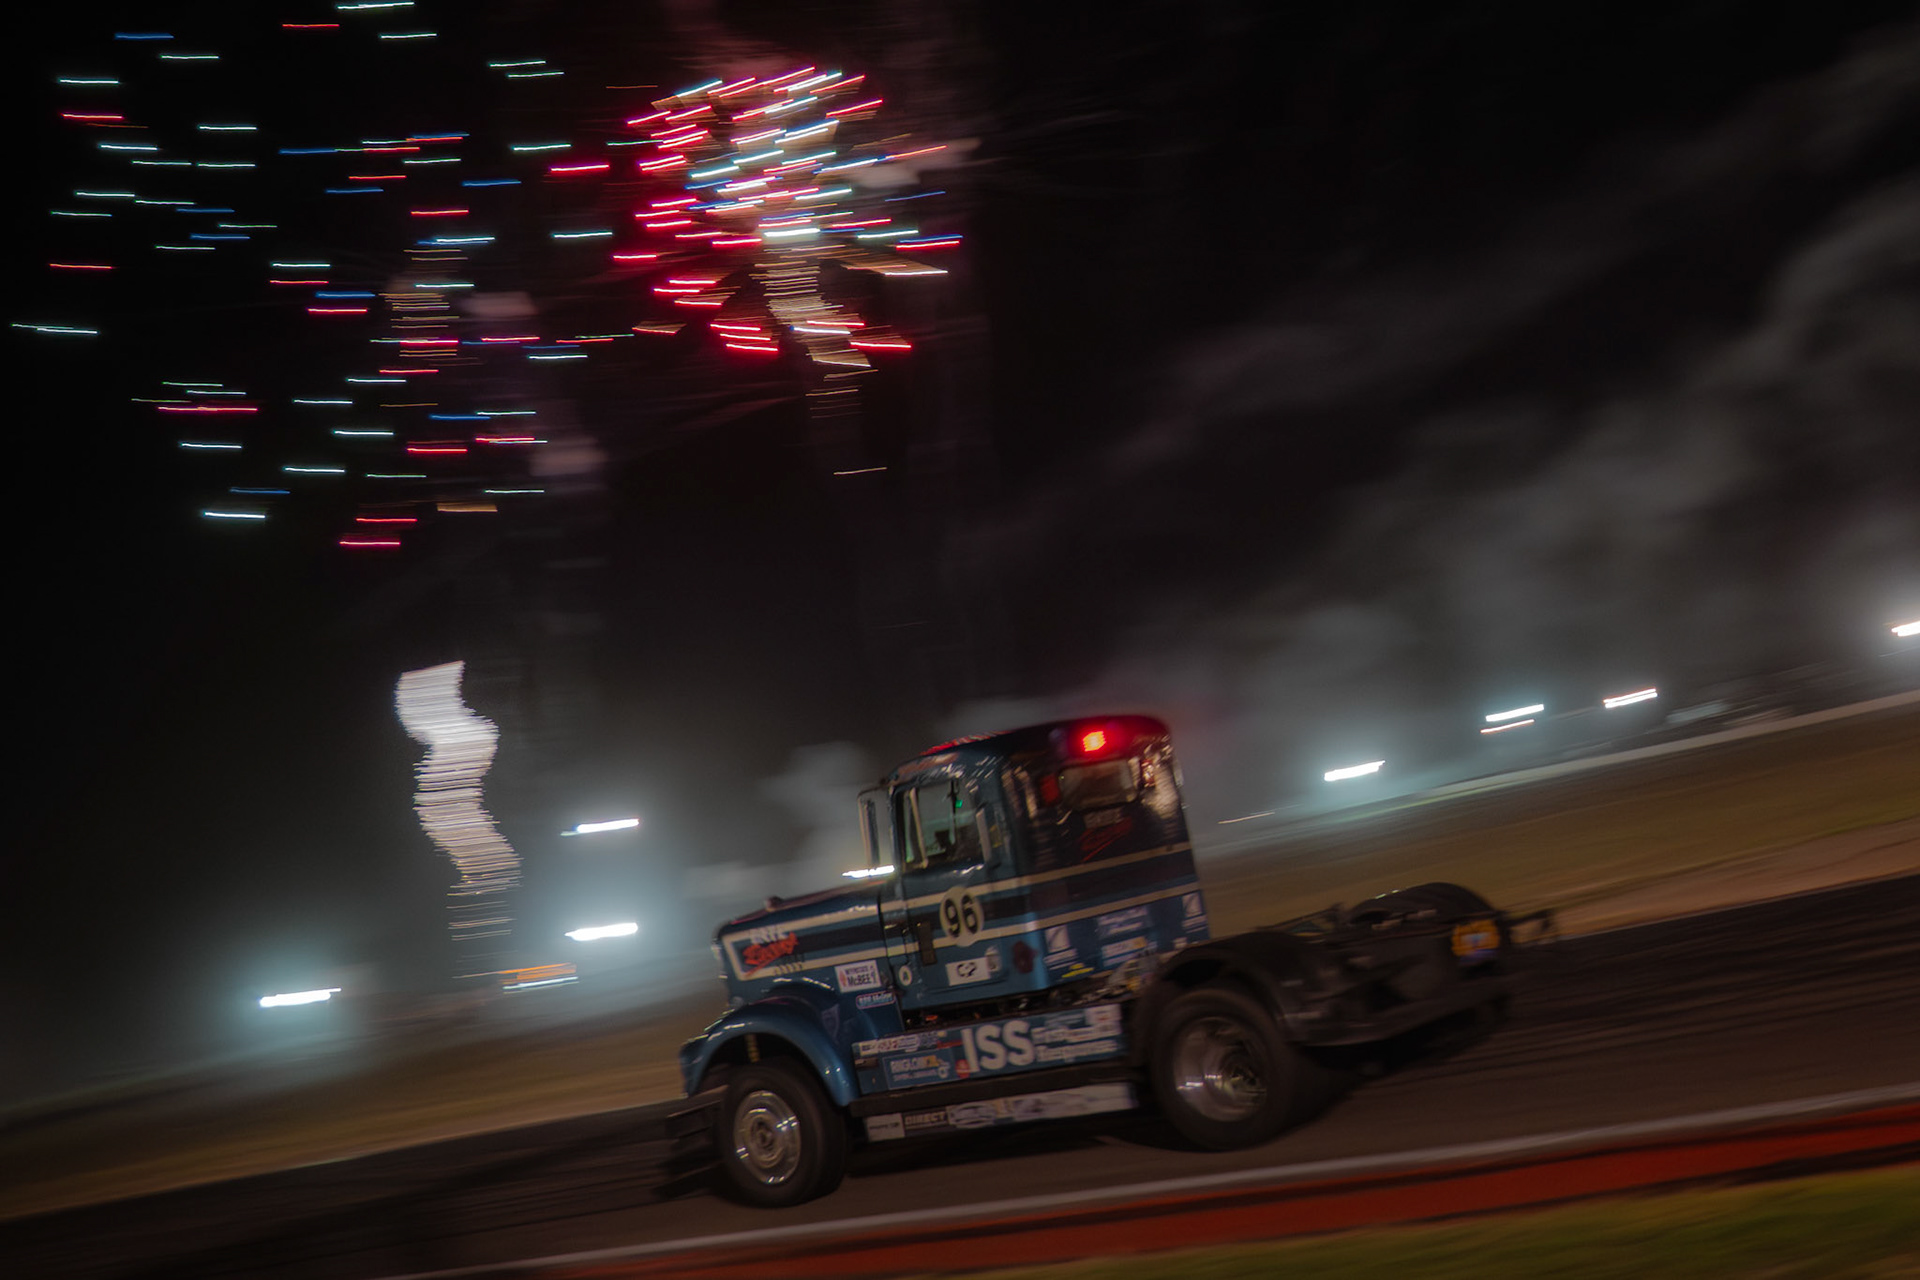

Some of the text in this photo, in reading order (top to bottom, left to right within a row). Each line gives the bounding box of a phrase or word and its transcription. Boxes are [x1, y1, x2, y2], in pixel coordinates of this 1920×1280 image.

[944, 894, 974, 938] 96
[960, 1019, 1036, 1073] ISS
[904, 1111, 948, 1127] DIRECT
